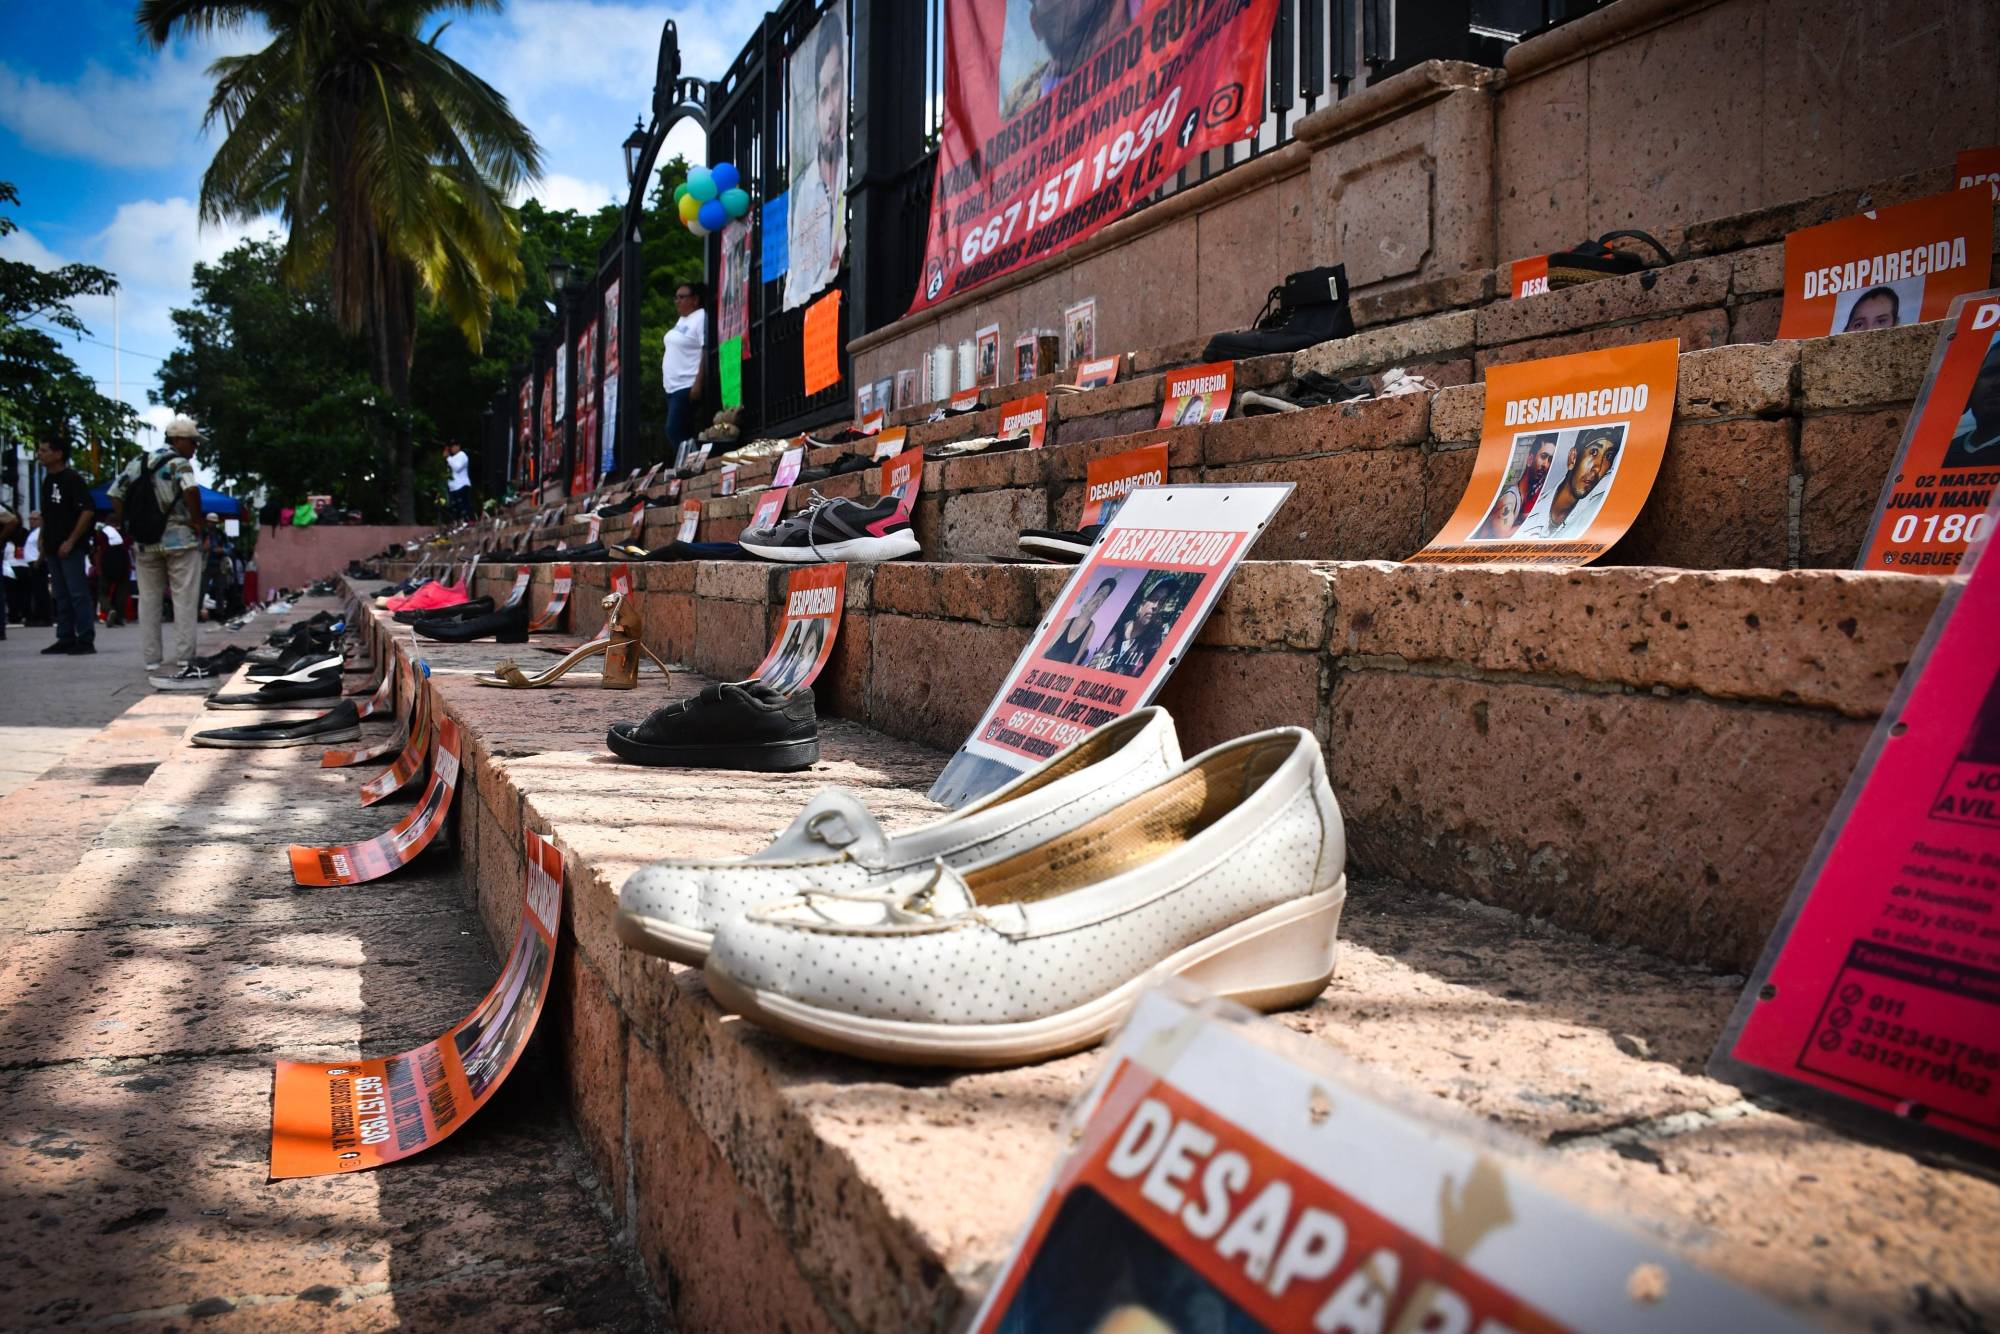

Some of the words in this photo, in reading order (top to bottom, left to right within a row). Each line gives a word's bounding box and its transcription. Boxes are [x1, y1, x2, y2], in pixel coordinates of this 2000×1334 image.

[985, 97, 1053, 173] ARISTEO
[1056, 26, 1143, 122] GALINDO
[1021, 154, 1036, 187] LA
[1040, 119, 1085, 174] PALMA
[961, 201, 1022, 265] 667
[1026, 158, 1084, 231] 157
[1092, 86, 1181, 191] 1930
[953, 237, 1026, 290] SABUESOS
[1803, 237, 1967, 300] DESAPARECIDA
[1172, 373, 1227, 398] DESAPARECIDA
[1504, 384, 1649, 426] DESAPARECIDO
[1915, 475, 1936, 488] 02
[1939, 471, 2000, 488] MARZO
[1886, 491, 1937, 509] JUAN
[1102, 529, 1237, 566] DESAPARECIDO
[787, 586, 837, 616] DESAPARECIDA
[1024, 669, 1040, 684] 25
[1034, 671, 1057, 689] JULIO
[1050, 674, 1074, 693] 2020
[1072, 679, 1113, 702] CULIACÁN
[1007, 710, 1034, 730] 667
[1029, 716, 1057, 736] 157
[1057, 697, 1088, 723] LÓPEZ
[1883, 904, 1920, 923] 7:30
[330, 1078, 352, 1105] SABUESOS
[354, 1076, 384, 1096] 667
[356, 1097, 388, 1115] 157
[360, 1116, 390, 1145] 1930
